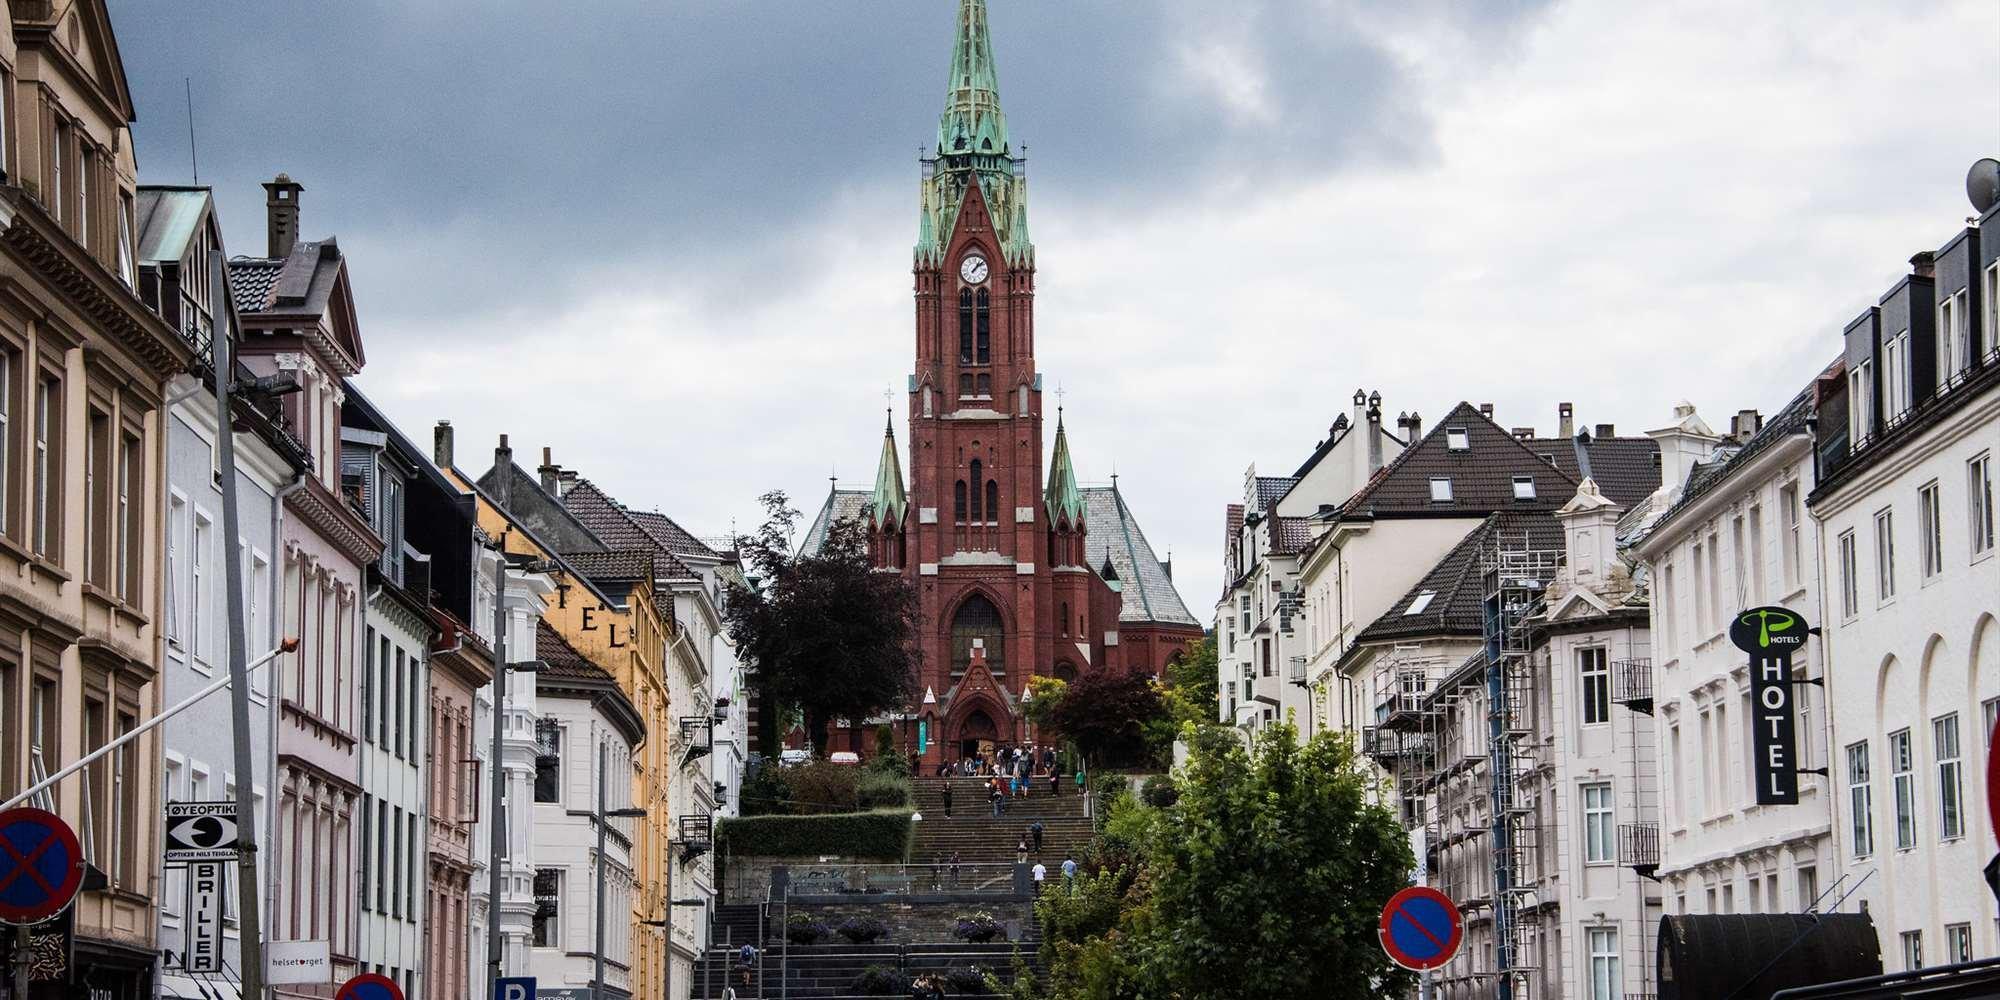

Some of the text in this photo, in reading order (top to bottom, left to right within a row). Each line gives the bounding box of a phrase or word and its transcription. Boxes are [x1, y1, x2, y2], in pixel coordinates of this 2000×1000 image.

[1770, 636, 1800, 644] HOTELS
[1761, 658, 1785, 796] HOTEL
[195, 865, 214, 969] BRILLER
